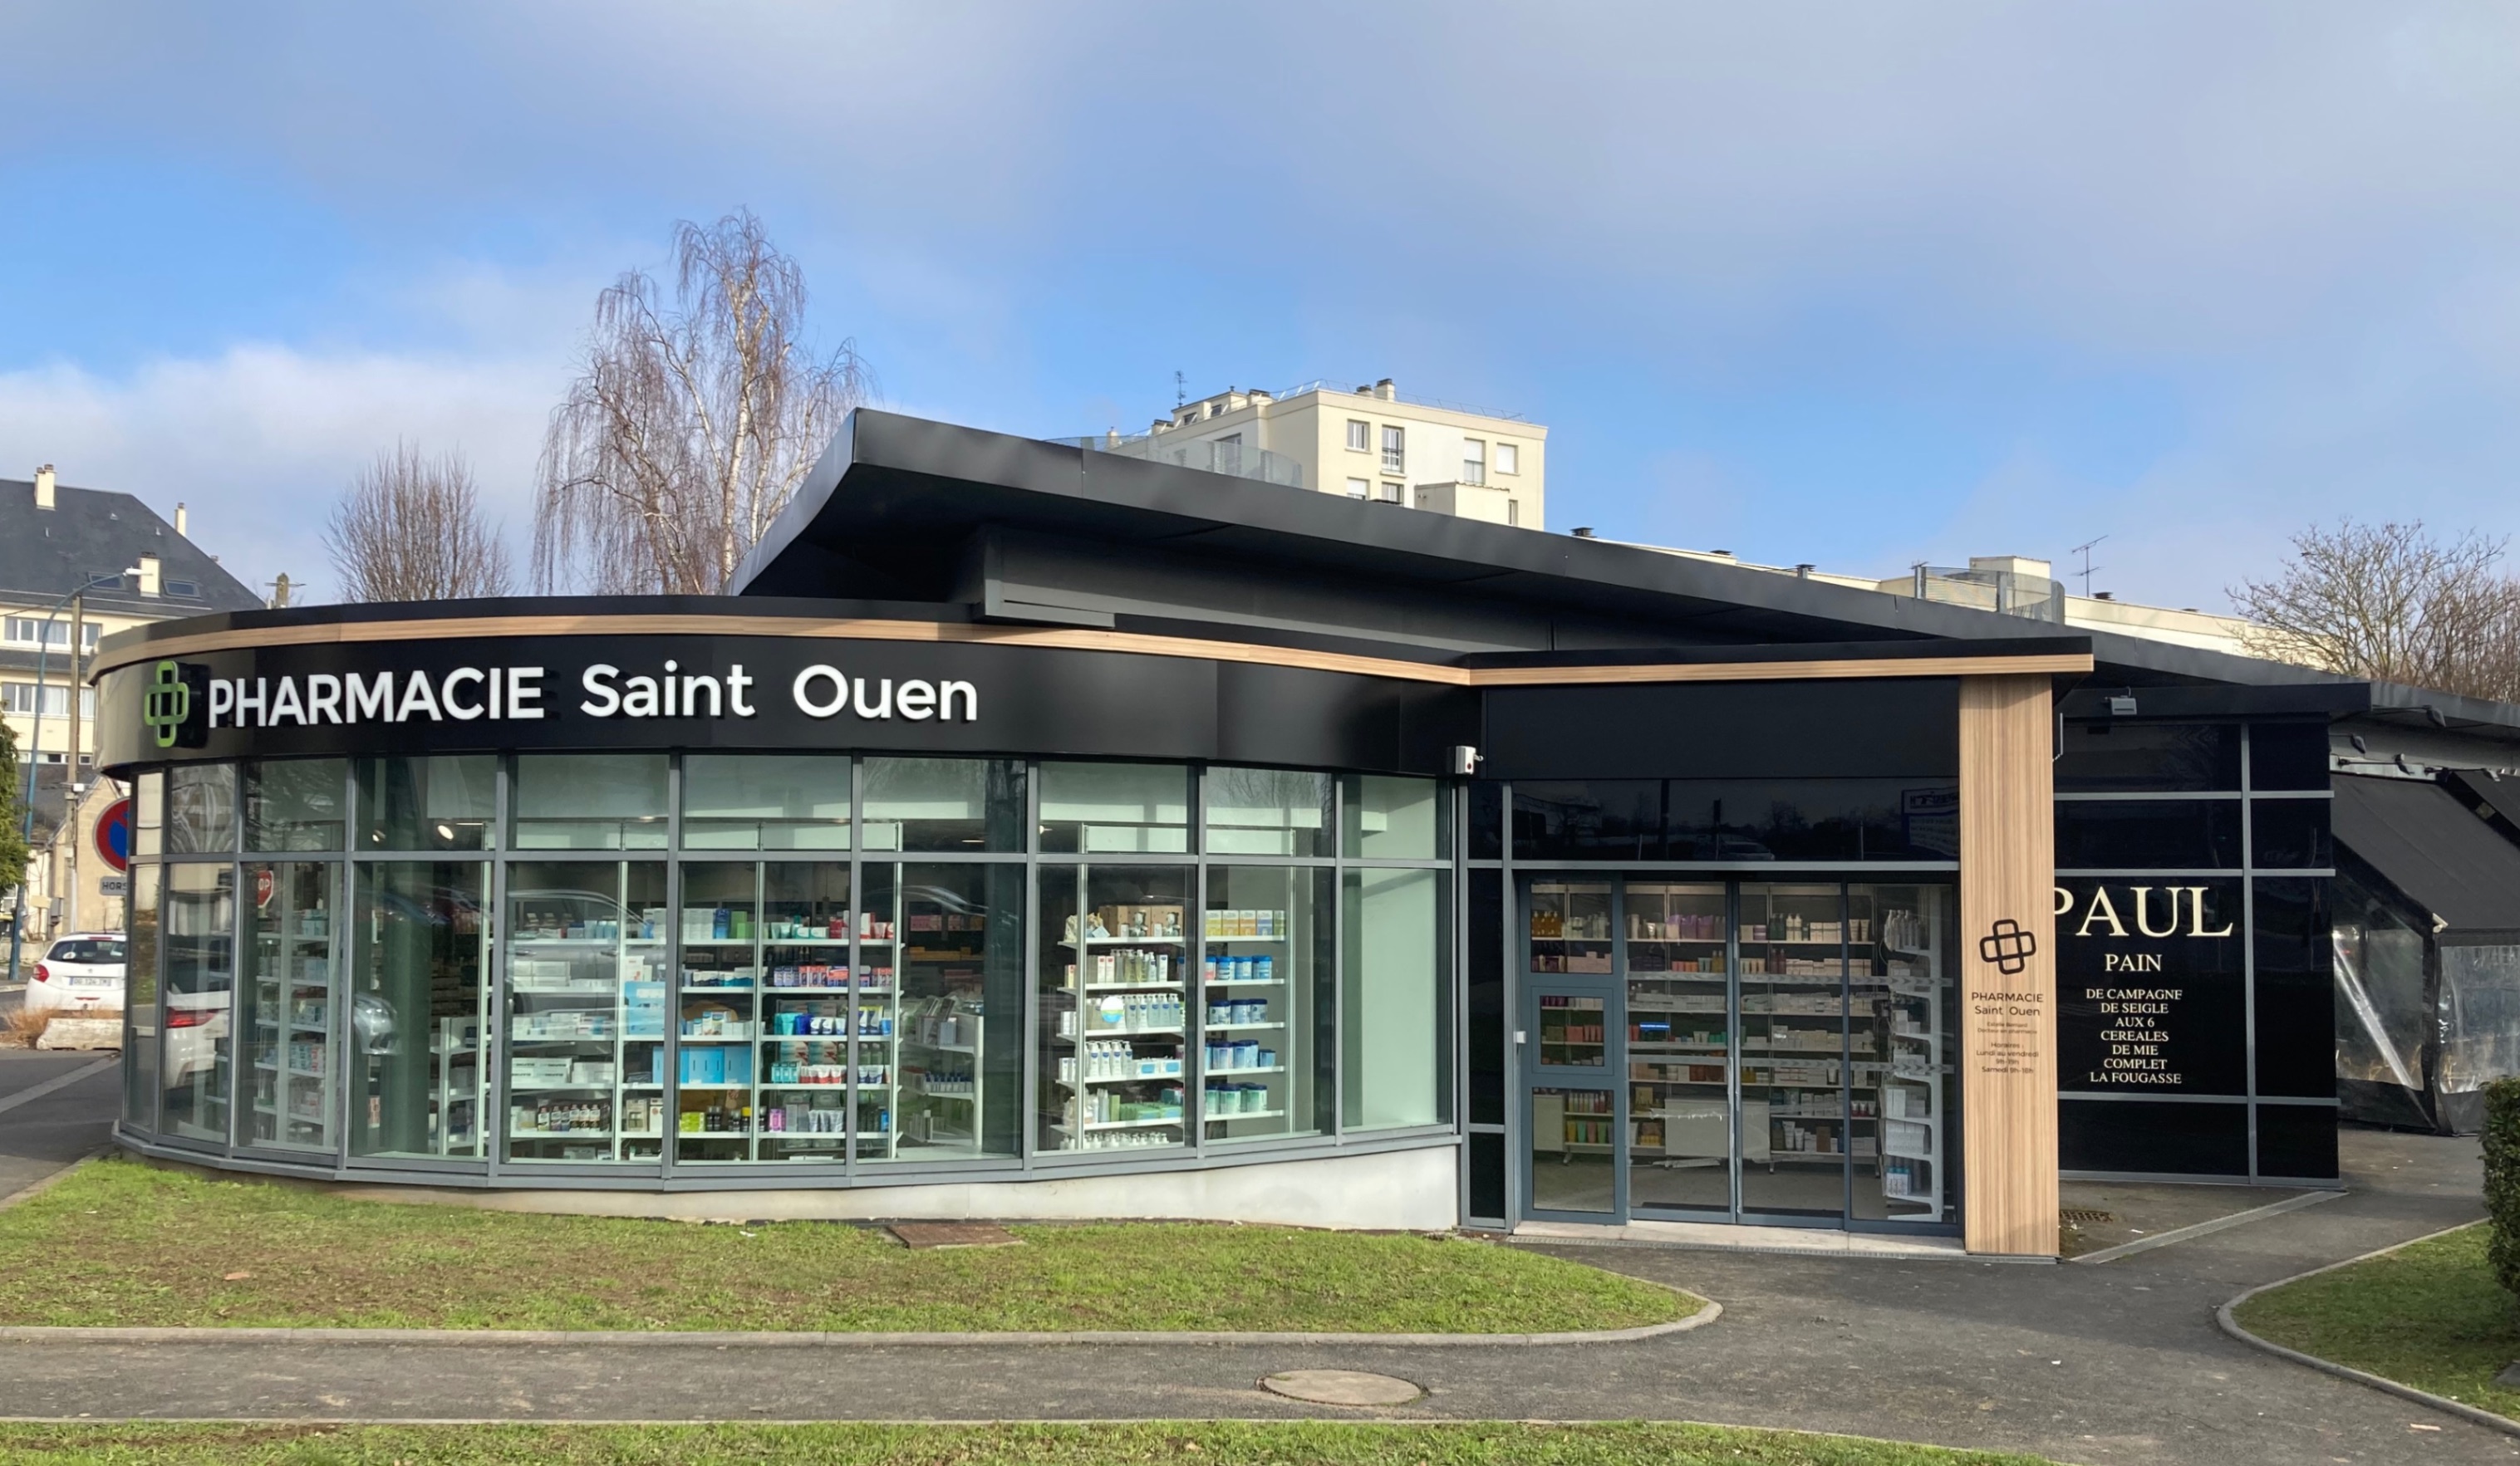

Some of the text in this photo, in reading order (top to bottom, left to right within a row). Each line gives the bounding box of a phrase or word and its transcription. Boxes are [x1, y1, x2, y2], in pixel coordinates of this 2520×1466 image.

[209, 660, 977, 728] PHARMACIE Saint Ouen
[2055, 885, 2233, 938] PAUL
[2105, 954, 2162, 972] PAIN
[1972, 992, 2044, 1003] PHARMACIE
[2085, 988, 2183, 1000] DE CAMPAGNE
[1975, 1005, 2041, 1016] Saint Ouen
[2100, 1003, 2169, 1014] DE SEIGLE
[2115, 1017, 2155, 1027] AUX 6
[2100, 1030, 2169, 1042] CEREALES
[2112, 1044, 2159, 1056] DE MIE
[2103, 1058, 2168, 1070] COMPLET
[2090, 1071, 2182, 1084] LA FOUGASSE
